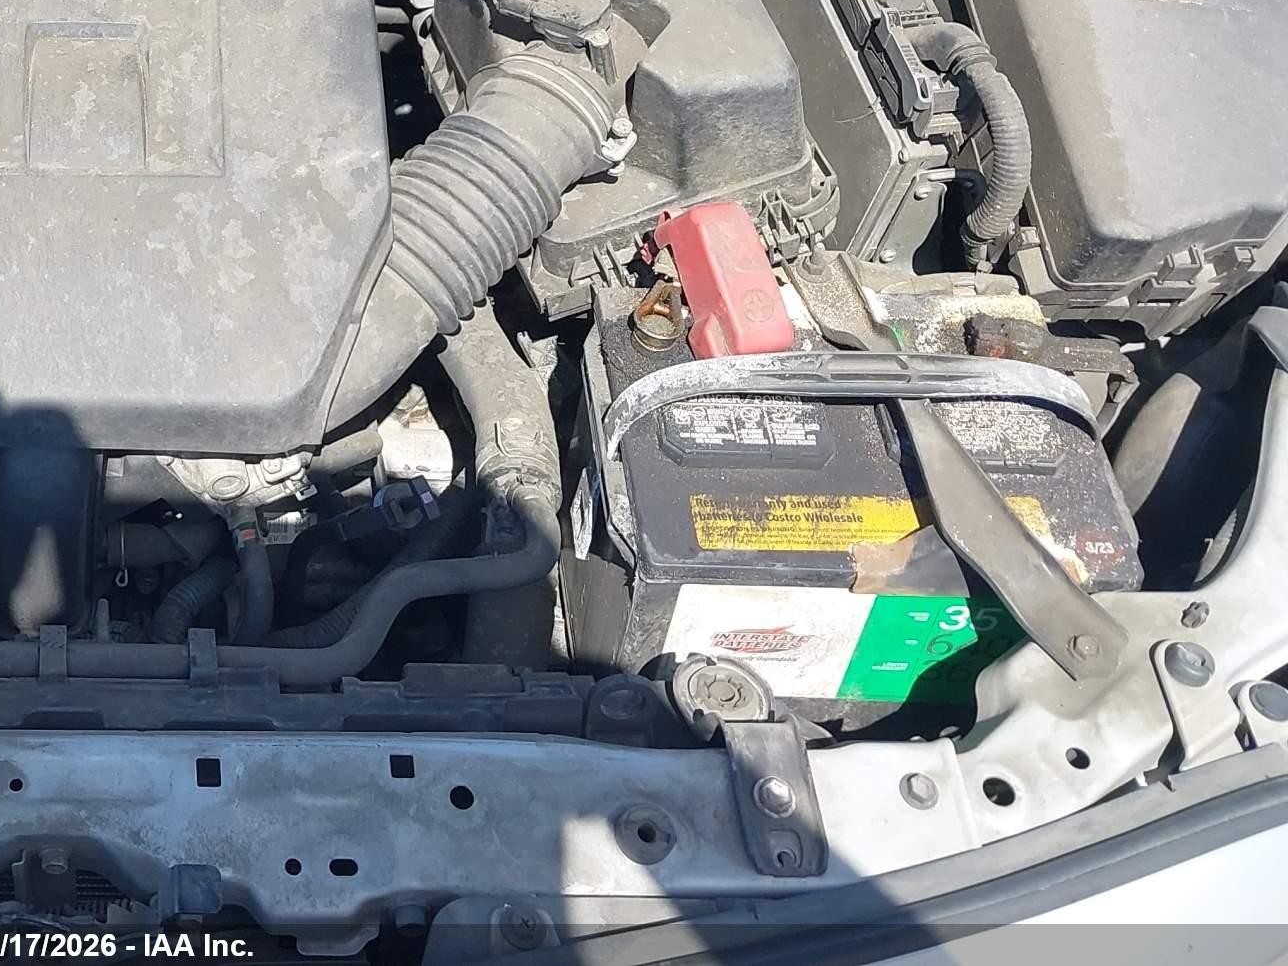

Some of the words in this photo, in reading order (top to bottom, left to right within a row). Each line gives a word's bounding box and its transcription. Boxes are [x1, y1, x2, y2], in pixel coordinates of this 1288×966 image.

[790, 498, 814, 509] and
[815, 499, 841, 510] used
[765, 512, 801, 523] Costco
[803, 512, 864, 523] Wholesale
[1084, 541, 1115, 554] 3/23
[938, 605, 1003, 631] 35
[712, 633, 810, 644] INTERSTATE
[712, 640, 802, 649] BATTERIES
